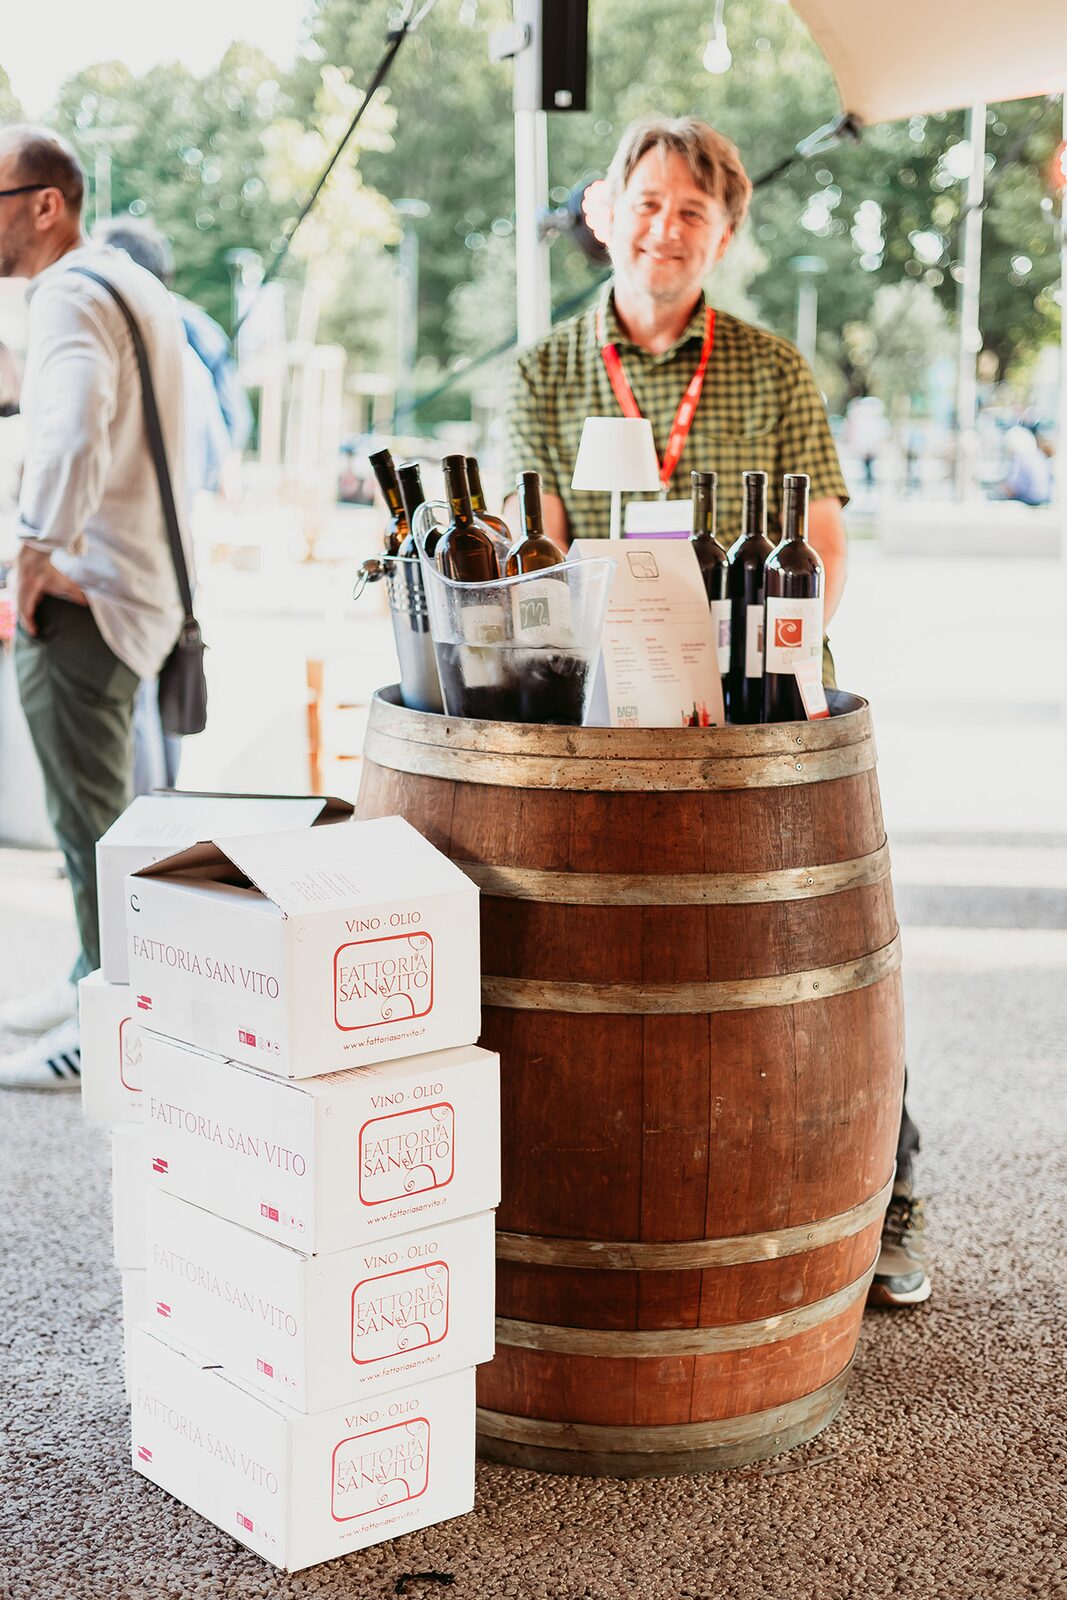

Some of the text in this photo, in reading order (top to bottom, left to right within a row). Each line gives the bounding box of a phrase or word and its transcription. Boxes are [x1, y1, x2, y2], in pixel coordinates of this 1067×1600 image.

[344, 911, 421, 933] VINO OLIO
[133, 935, 280, 999] FATTORIA SAN VITO
[339, 954, 428, 984] FATTORIA
[342, 1027, 426, 1051] www.fattoriasanvito.it
[370, 1082, 444, 1109] VINO OLIO
[150, 1097, 306, 1176] FATTORIA SAN VITO
[364, 1124, 449, 1160] FATTORIA
[366, 1197, 447, 1225] www.fattoriasanvito.it
[363, 1242, 438, 1269] VINO OLIO
[153, 1243, 298, 1337] FATTORIA SAN VITO
[357, 1283, 444, 1320] FATTORIA
[359, 1353, 441, 1383] www.fattoriasanvito.it
[344, 1399, 420, 1428] VINO OLIO
[136, 1386, 279, 1495] FATTORIA SAN VITO
[338, 1439, 424, 1478] FATTORIA
